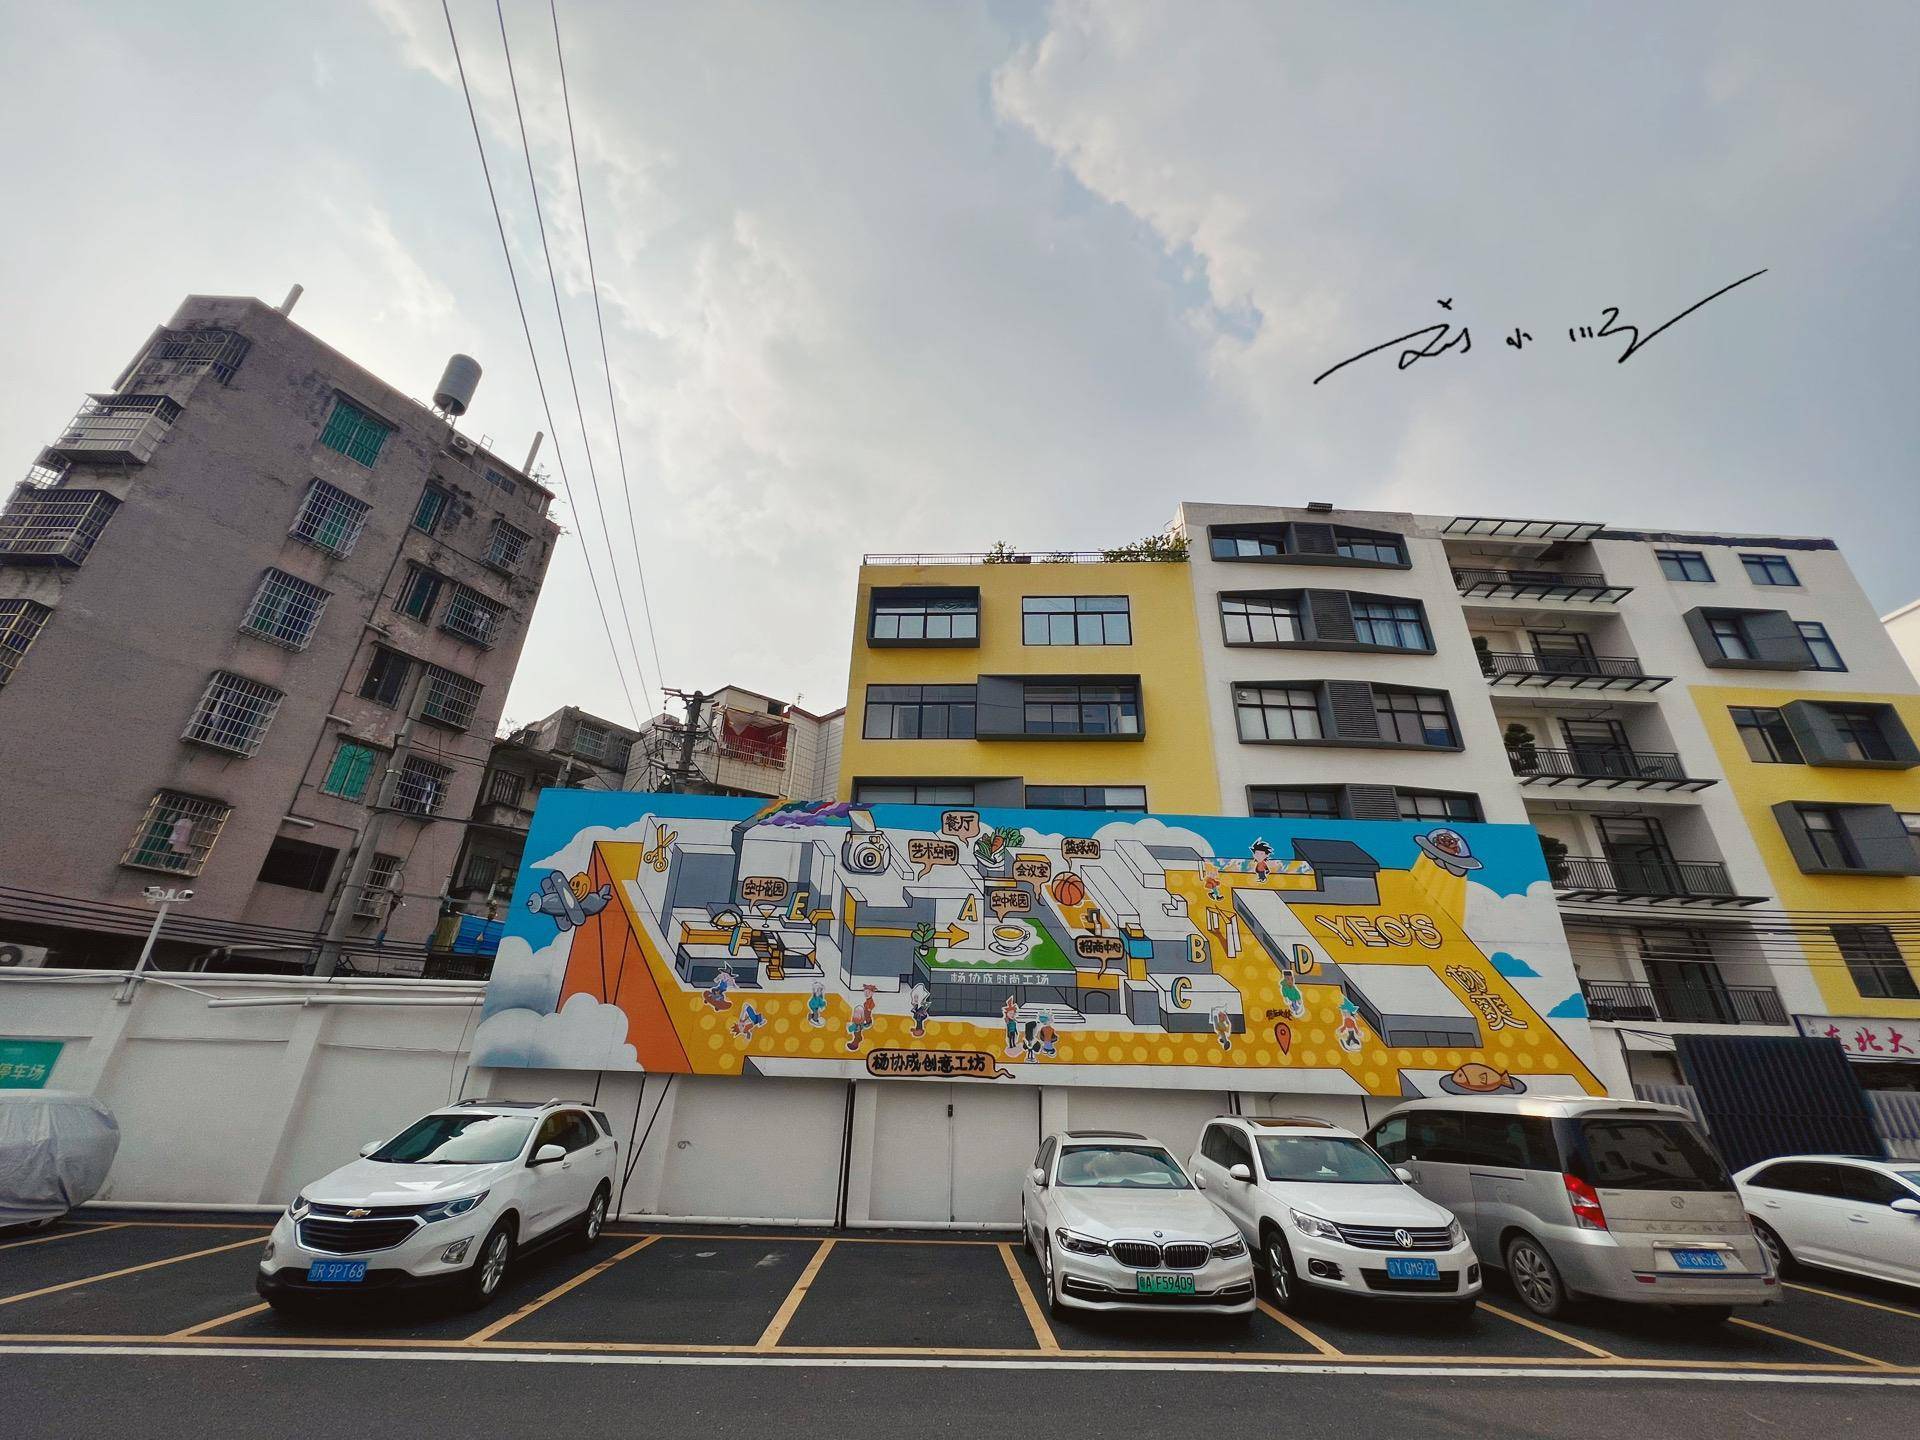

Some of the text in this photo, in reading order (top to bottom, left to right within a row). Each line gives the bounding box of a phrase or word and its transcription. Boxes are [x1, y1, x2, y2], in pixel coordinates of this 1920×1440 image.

[945, 813, 975, 832] 餐厅
[911, 842, 957, 862] 艺术空间
[1015, 864, 1049, 878] 会议室
[744, 880, 785, 897] 空中花园
[958, 893, 979, 923] A
[991, 892, 1029, 909] 空中花园
[1315, 914, 1442, 949] YEO'S
[1186, 933, 1207, 963] B
[1292, 944, 1314, 975] D
[950, 972, 1049, 985] 杨协成时尚工场
[1171, 976, 1192, 1009] C
[1824, 1024, 1920, 1054] 东北大
[872, 1052, 987, 1073] 杨协成创意工坊
